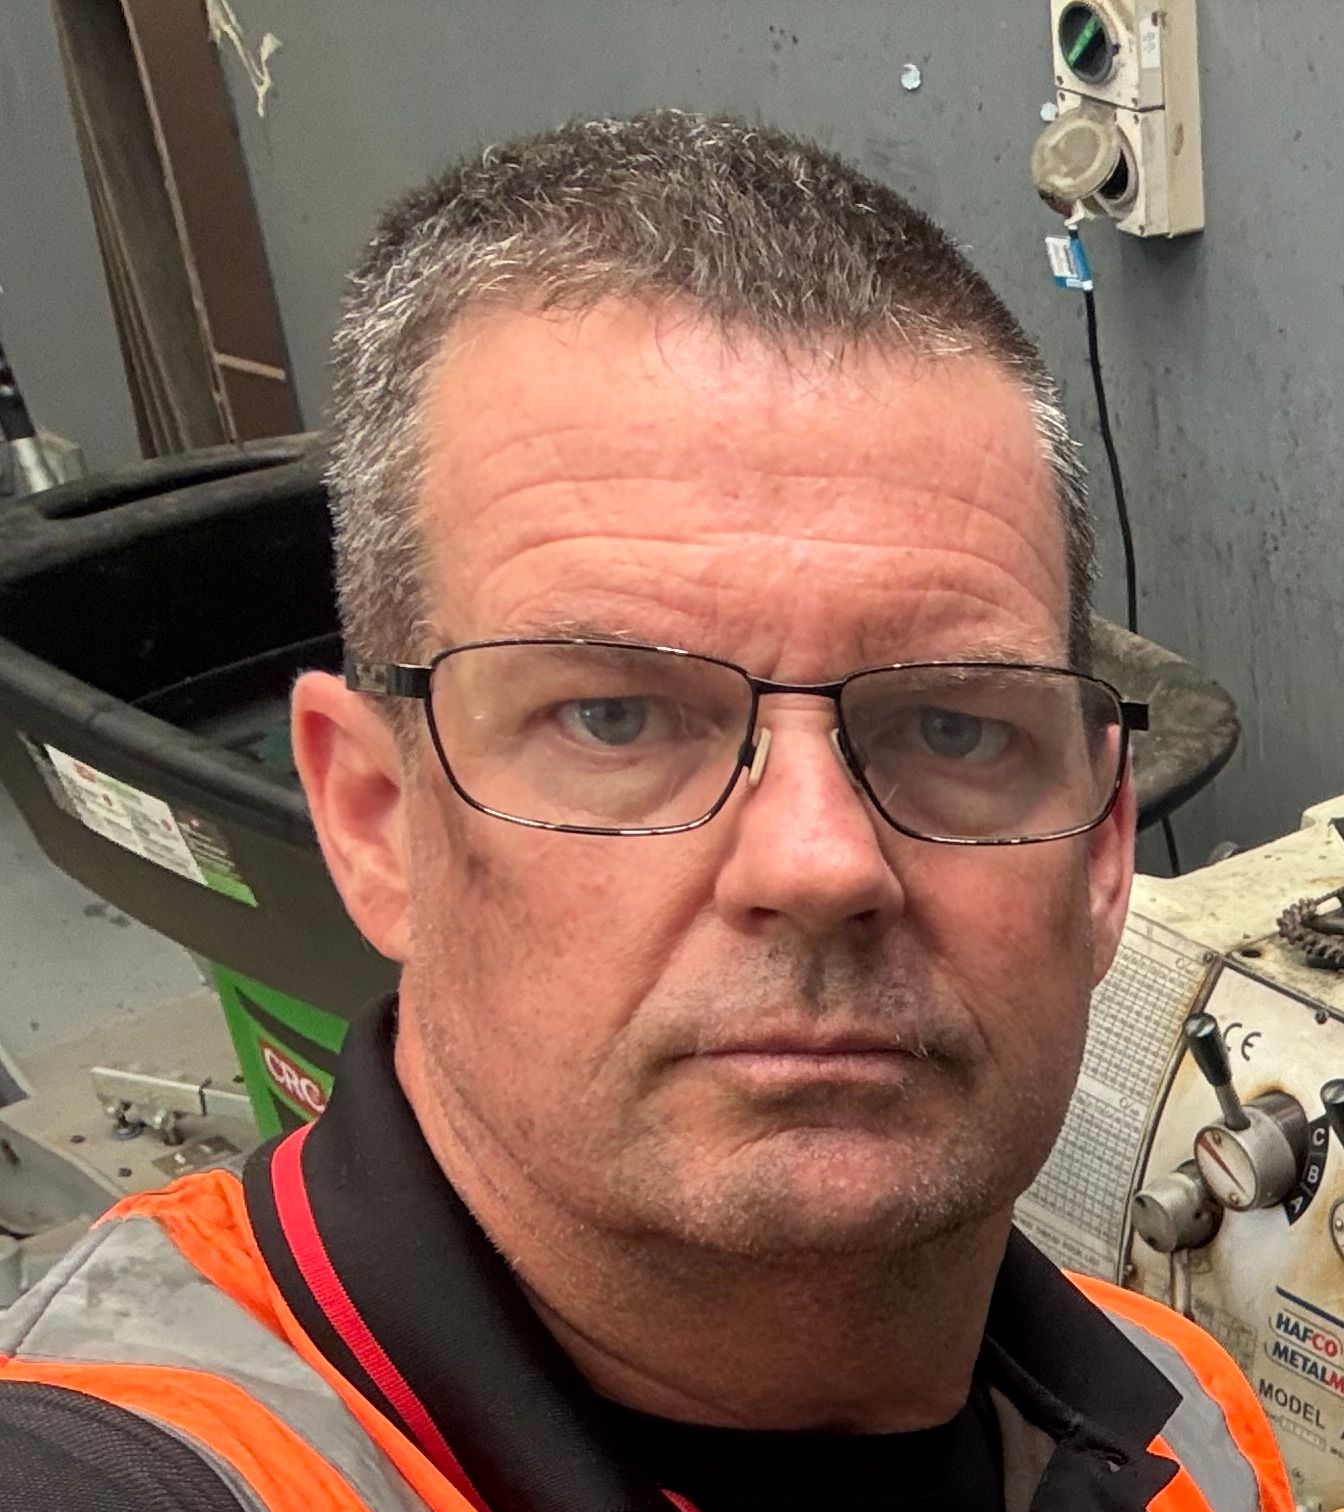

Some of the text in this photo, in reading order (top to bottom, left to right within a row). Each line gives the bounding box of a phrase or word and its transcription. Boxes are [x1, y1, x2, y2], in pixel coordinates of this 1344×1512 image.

[264, 1047, 326, 1114] CRC
[1312, 1127, 1326, 1147] C
[1307, 1164, 1320, 1184] B
[1275, 1312, 1339, 1358] HAFCO
[1258, 1378, 1326, 1430] MODEL
